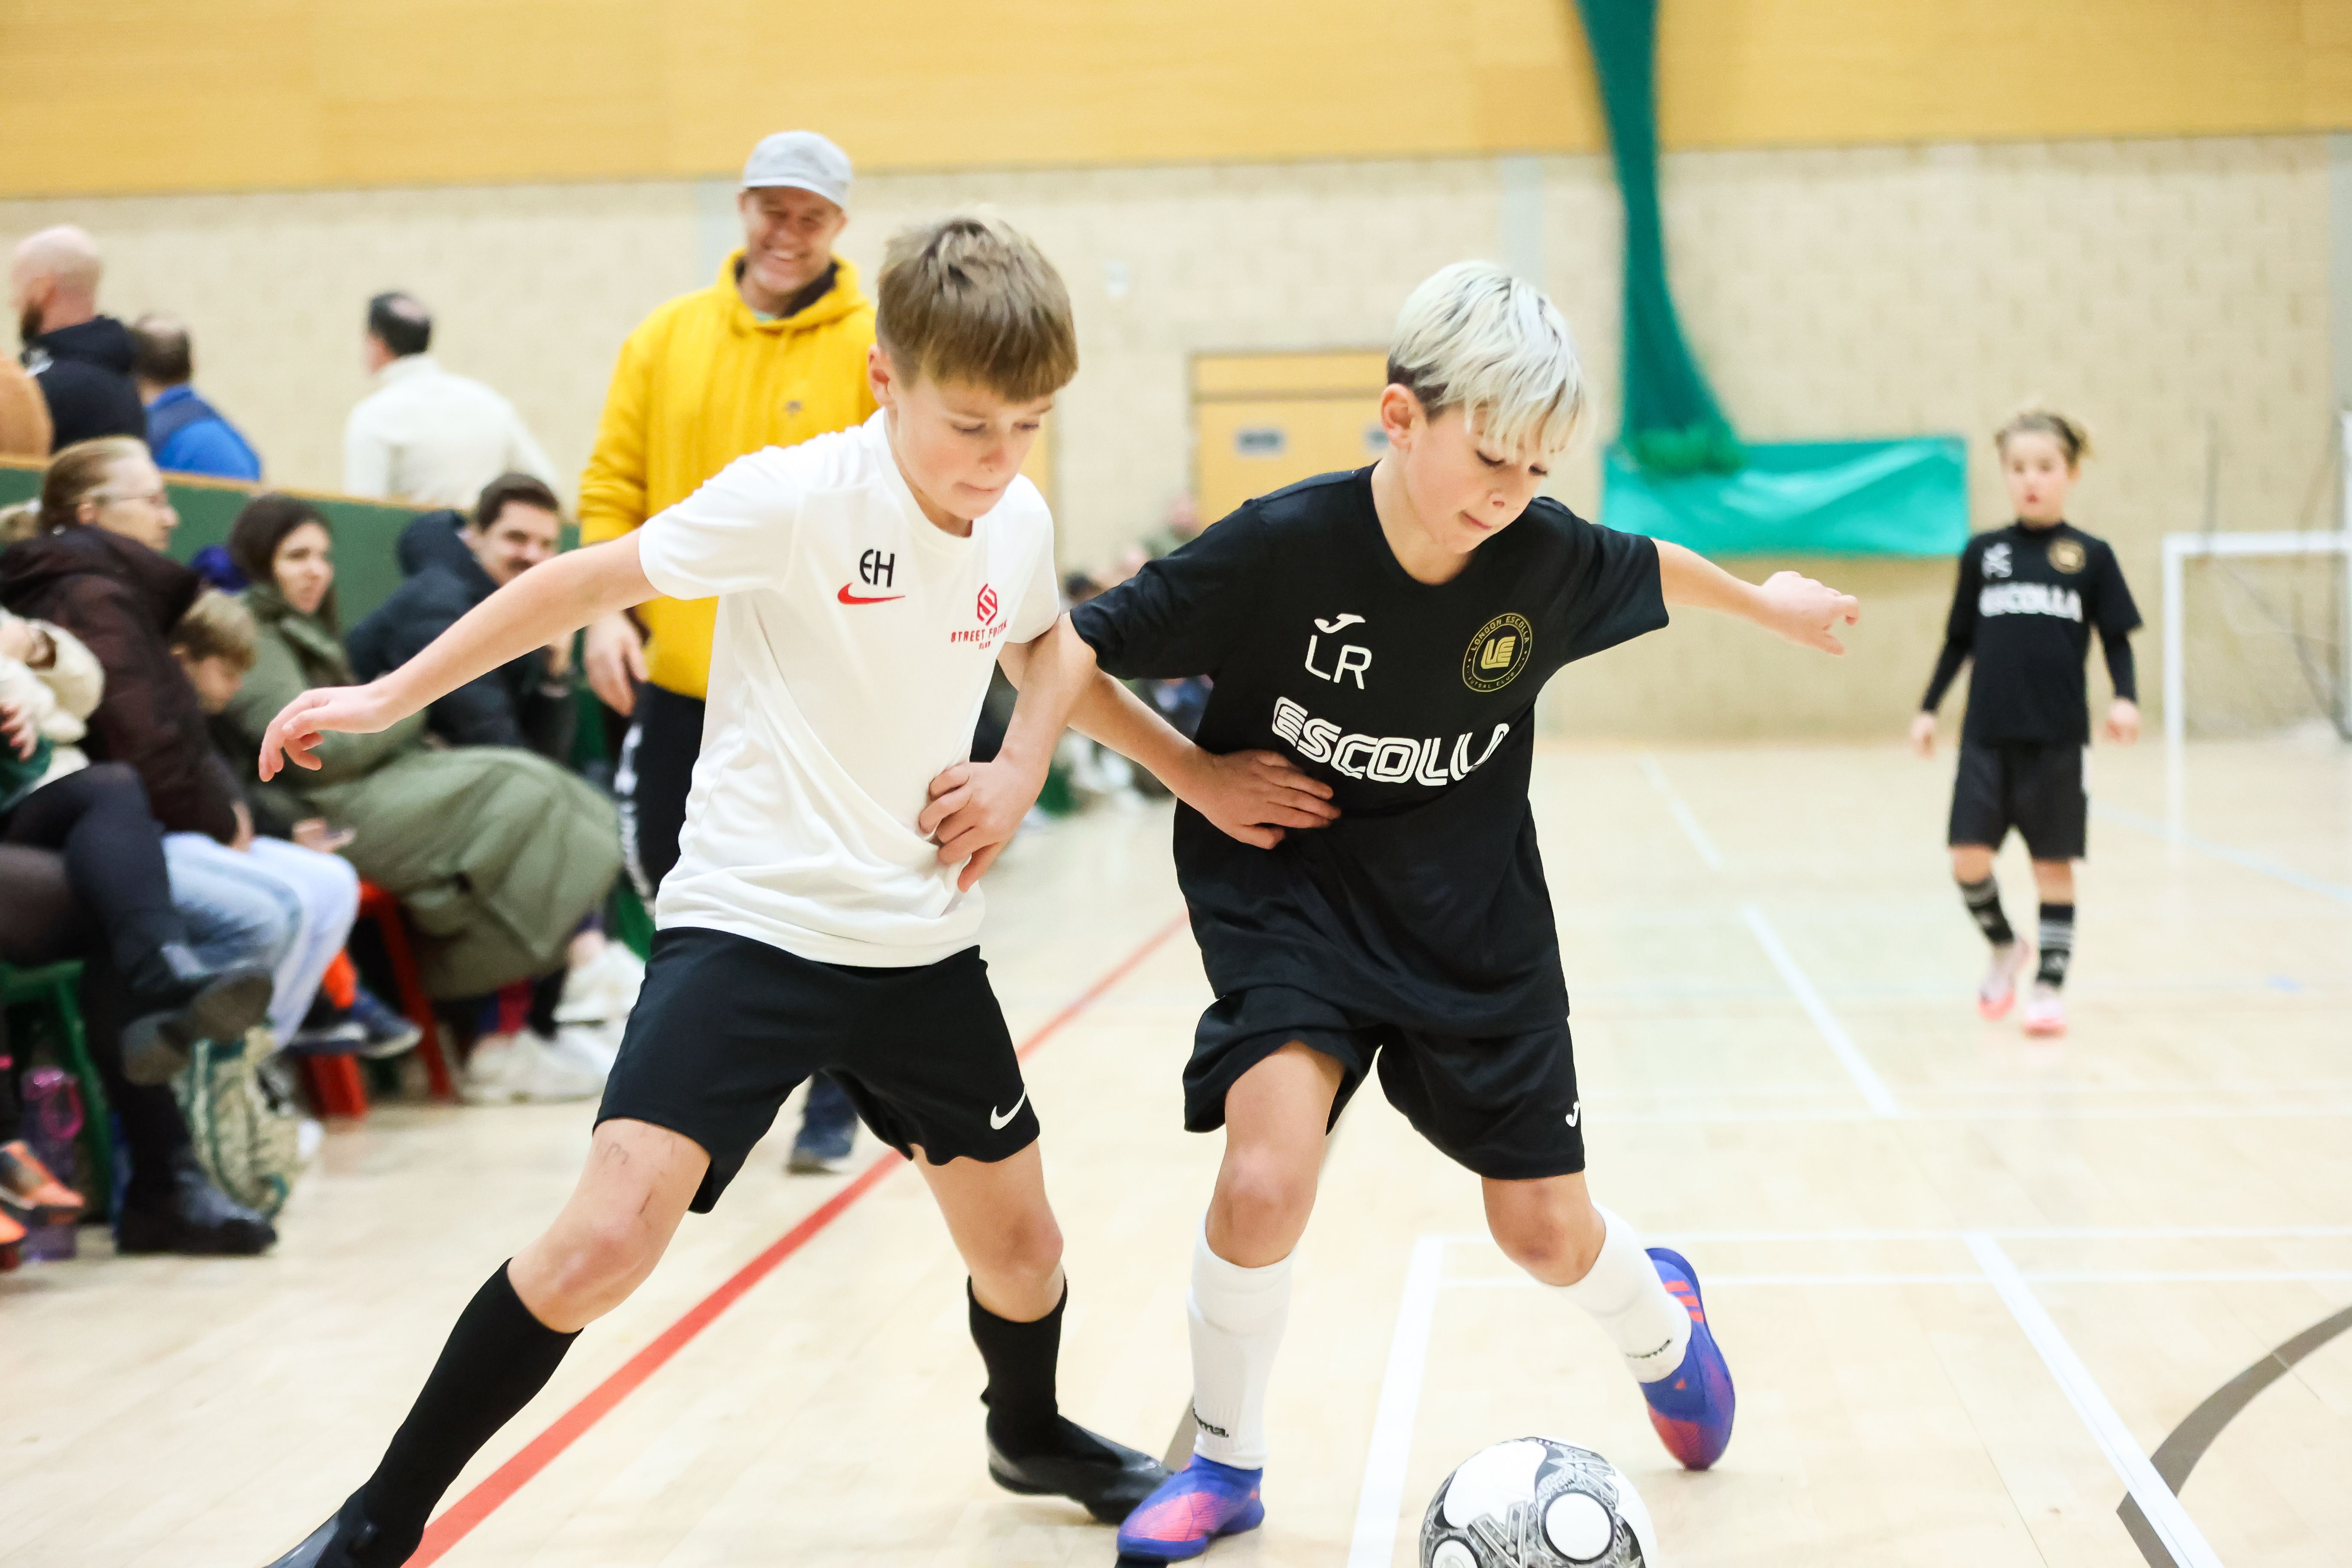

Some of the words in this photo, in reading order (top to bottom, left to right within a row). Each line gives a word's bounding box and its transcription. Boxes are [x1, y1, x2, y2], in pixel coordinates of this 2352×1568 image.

[860, 549, 895, 588] EH
[951, 629, 986, 643] STREET
[1470, 618, 1502, 651] LONDON
[1505, 615, 1530, 644] ESCOLLA
[1305, 635, 1372, 690] LR
[1468, 677, 1492, 689] FUTSAL
